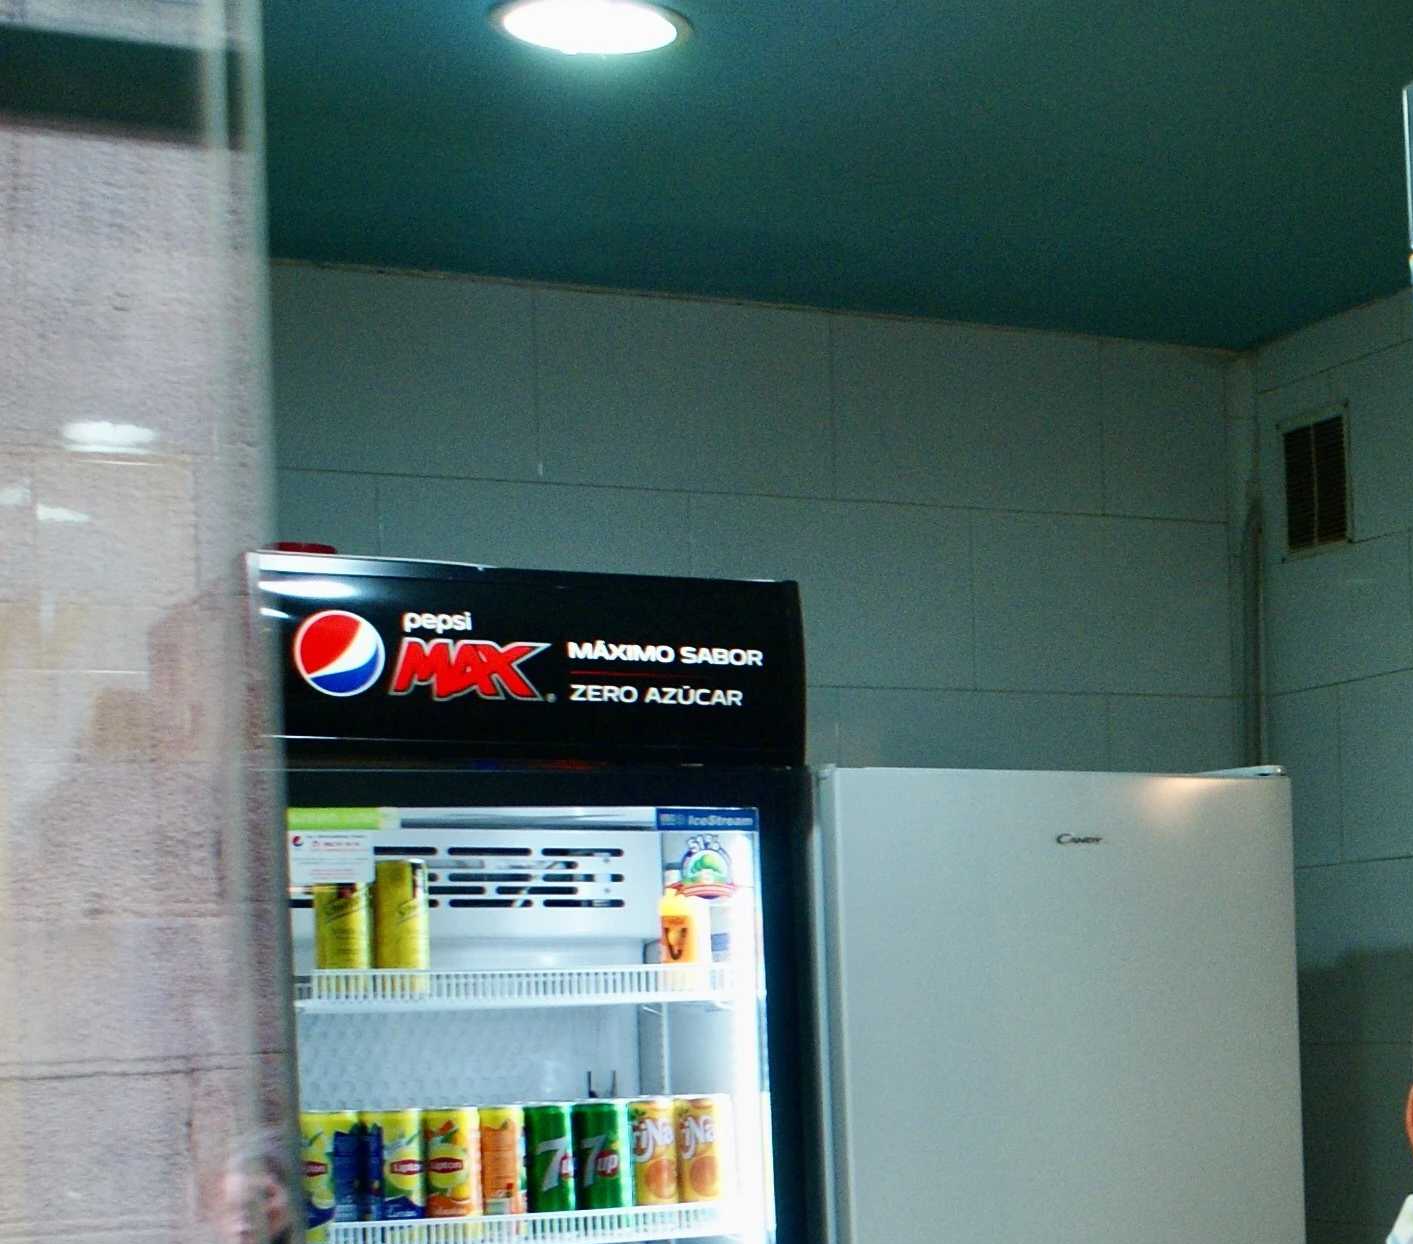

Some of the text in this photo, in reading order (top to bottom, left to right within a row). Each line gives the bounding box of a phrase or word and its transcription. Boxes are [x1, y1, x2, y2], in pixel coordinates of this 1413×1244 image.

[404, 611, 473, 634] pepsi
[567, 640, 763, 666] MÁXIMO SABOR
[388, 637, 552, 701] MAX
[570, 684, 743, 706] ZERO AZÚCAR
